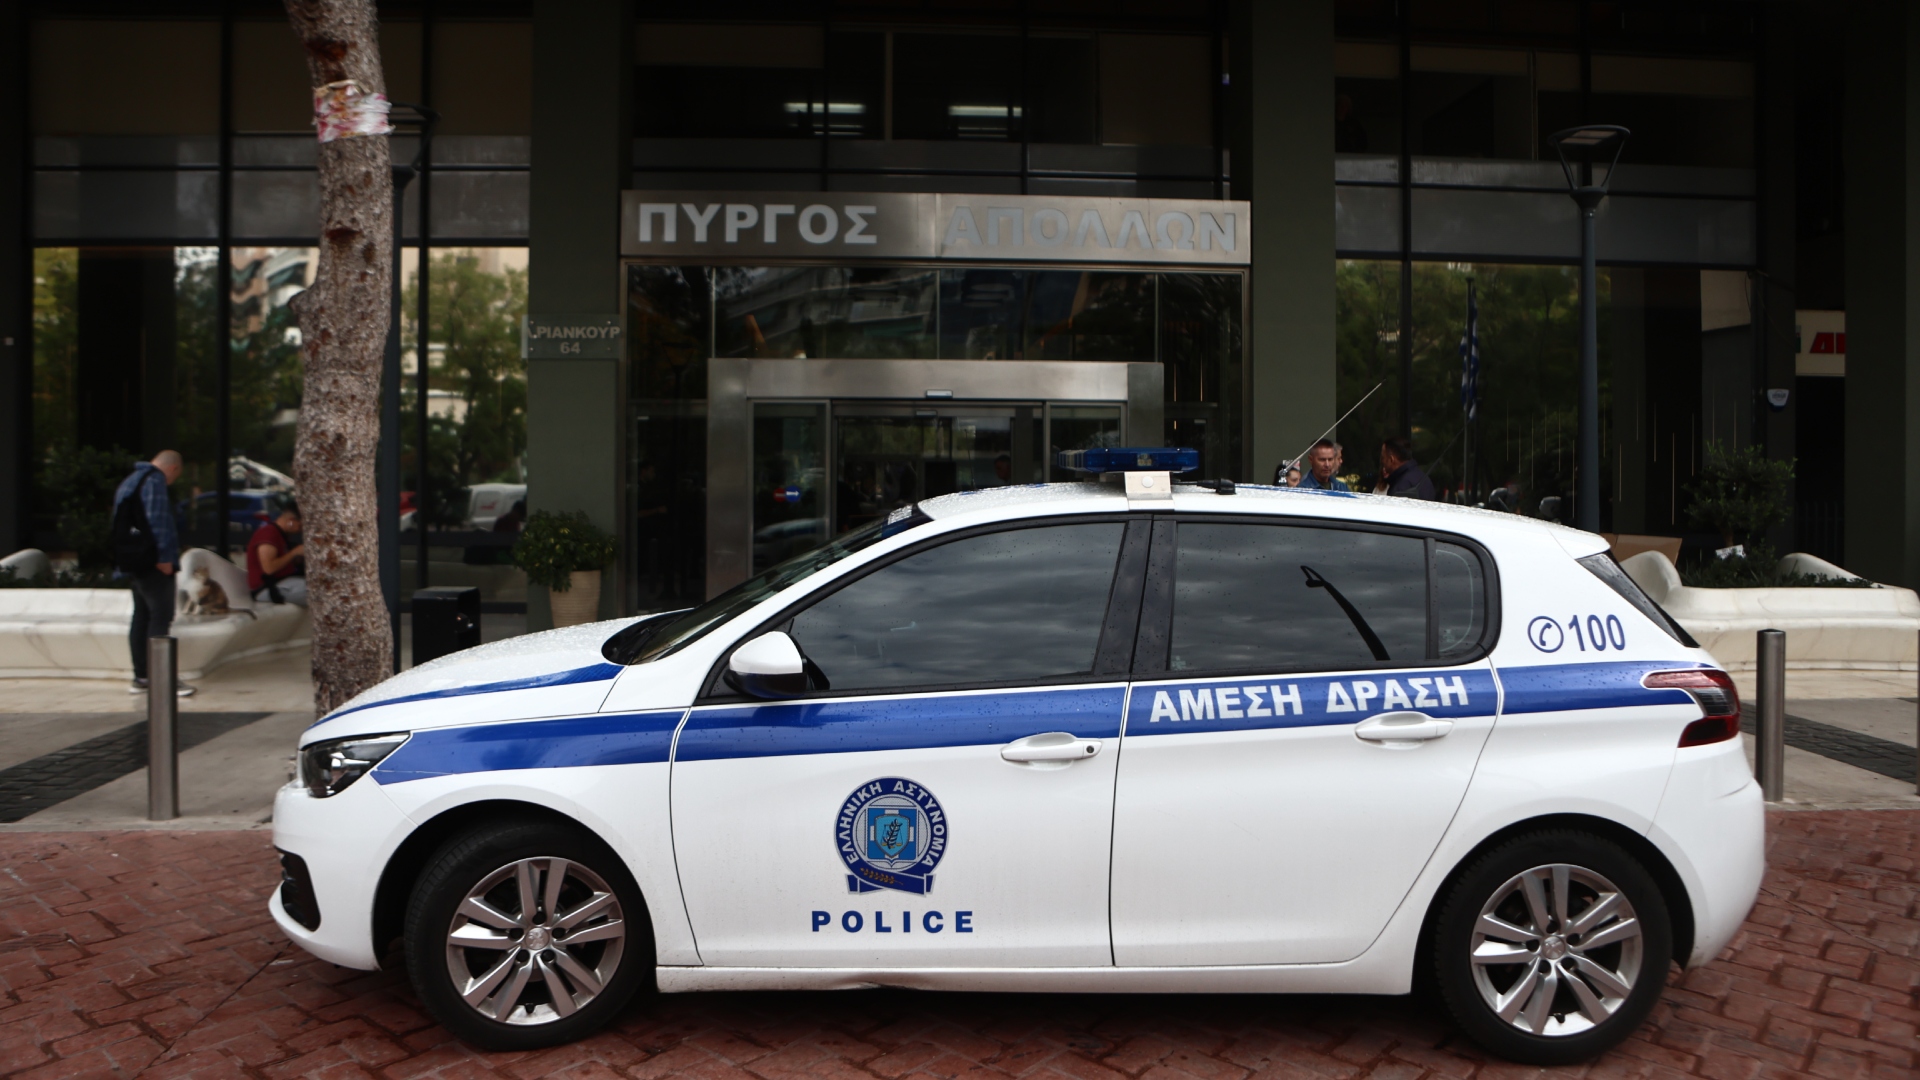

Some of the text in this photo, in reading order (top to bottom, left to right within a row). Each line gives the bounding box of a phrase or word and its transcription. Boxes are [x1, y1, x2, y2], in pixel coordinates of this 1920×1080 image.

[638, 202, 1236, 251] ΠΥΡΓΟΣ ΑΠΟΛΛΩΝ
[560, 341, 580, 354] 64
[1568, 613, 1626, 652] 100
[1149, 675, 1470, 723] ΑΜΕΣΗ ΔΡΑΣΗ
[838, 780, 945, 867] ΕΛΛΗΝΙΚΗ ΑΣΤΥΝΟΜΙΑ
[811, 910, 974, 933] POLICE
